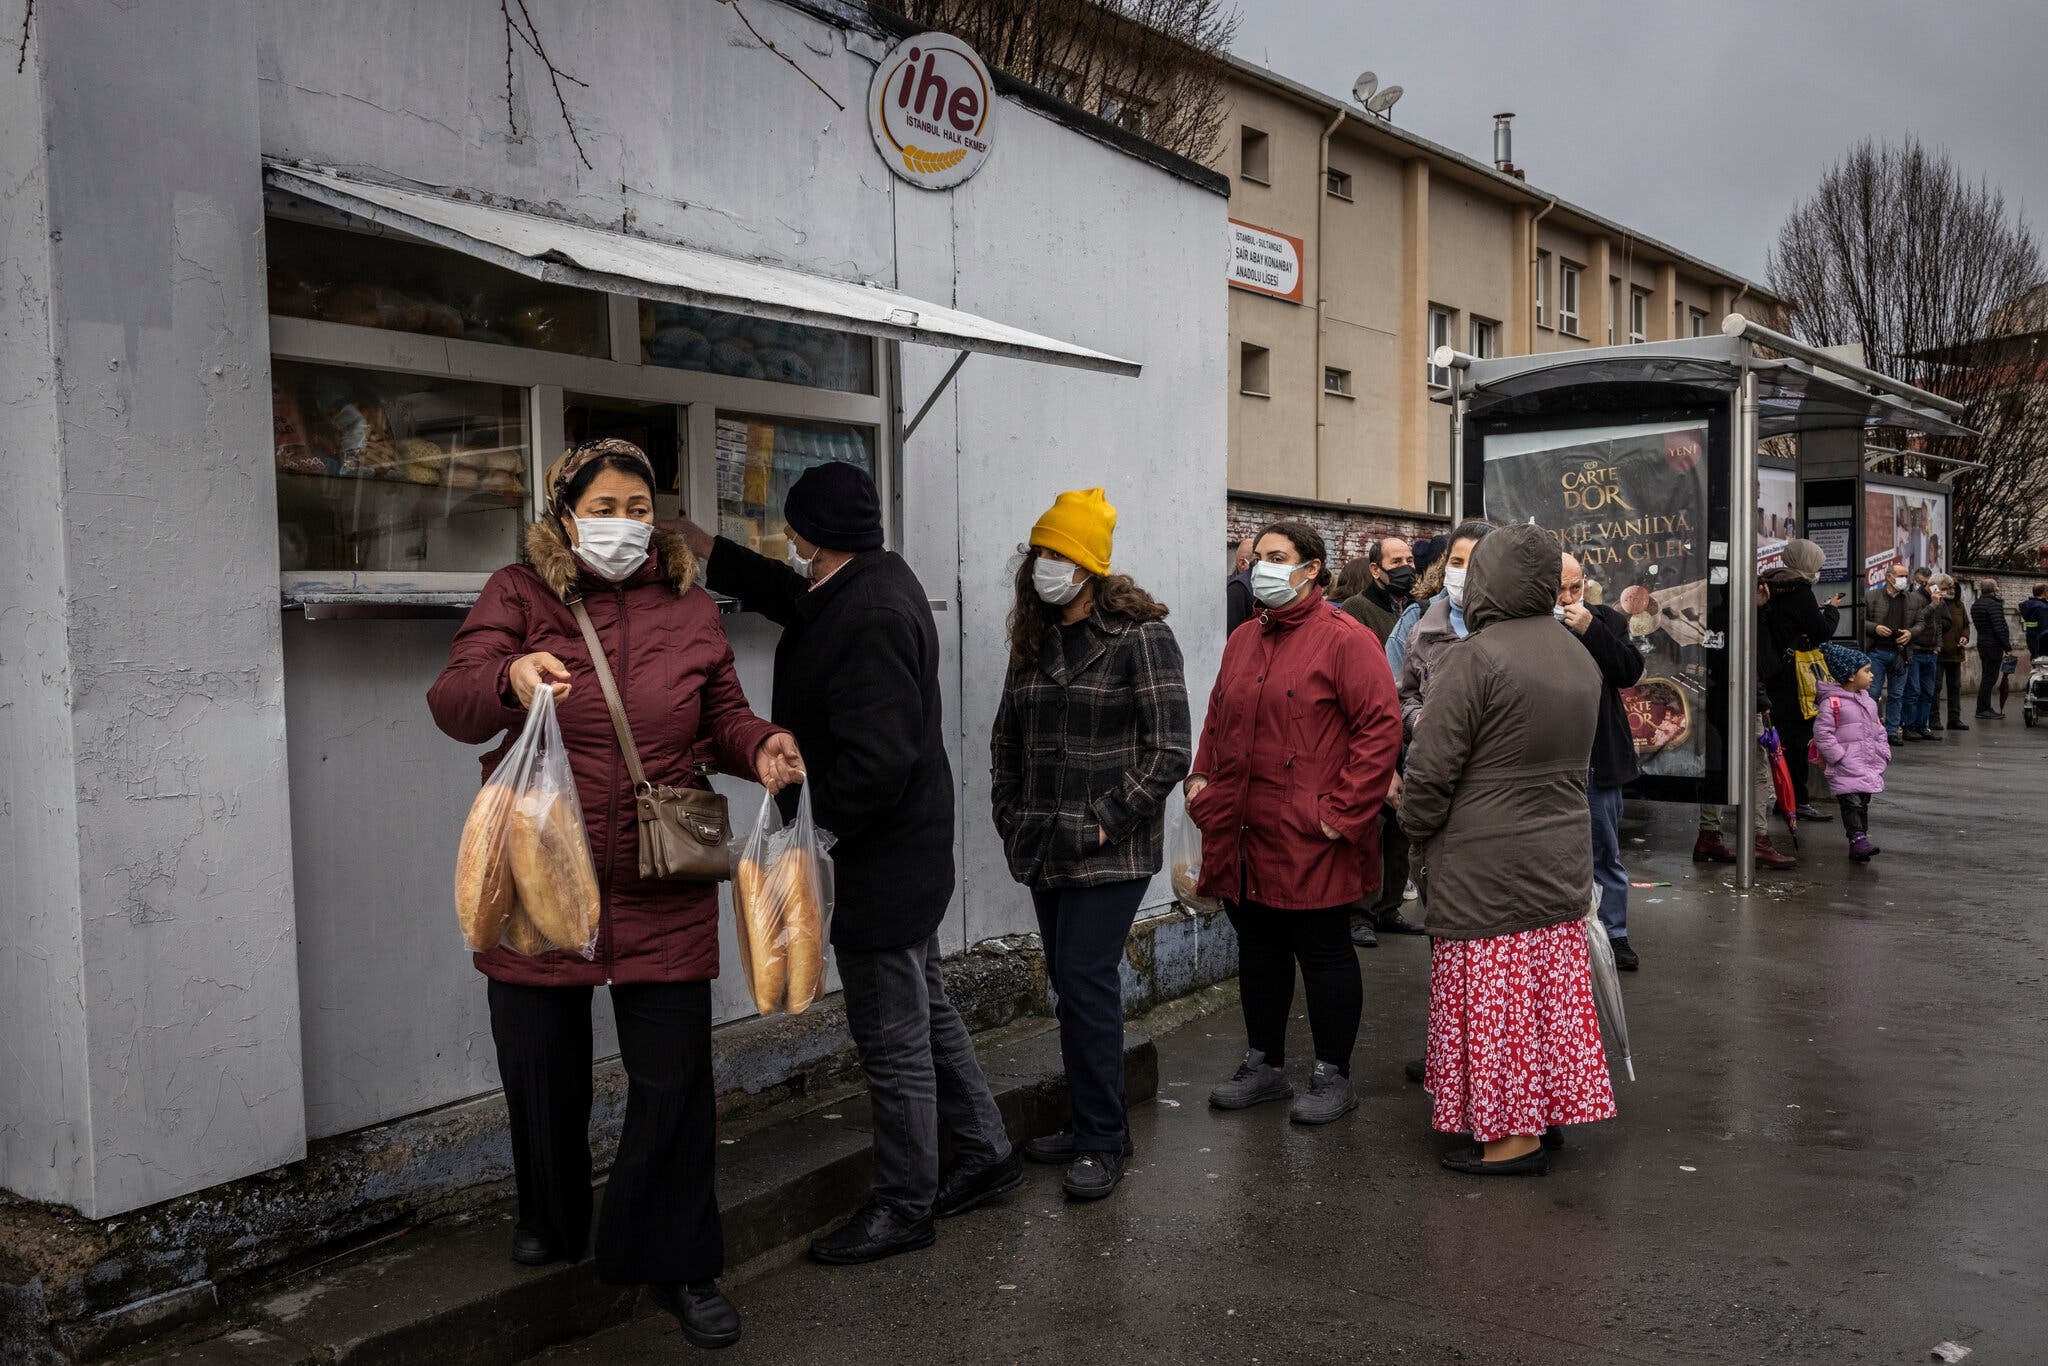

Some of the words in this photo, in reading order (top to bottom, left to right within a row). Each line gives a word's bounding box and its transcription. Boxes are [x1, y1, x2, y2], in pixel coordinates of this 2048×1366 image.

[898, 47, 979, 132] ihe
[906, 111, 941, 137] İSTANBUL
[943, 128, 962, 145] HALK
[1249, 251, 1263, 265] ABAY
[1236, 265, 1262, 282] ANADOLU
[1561, 466, 1618, 490] CARTE
